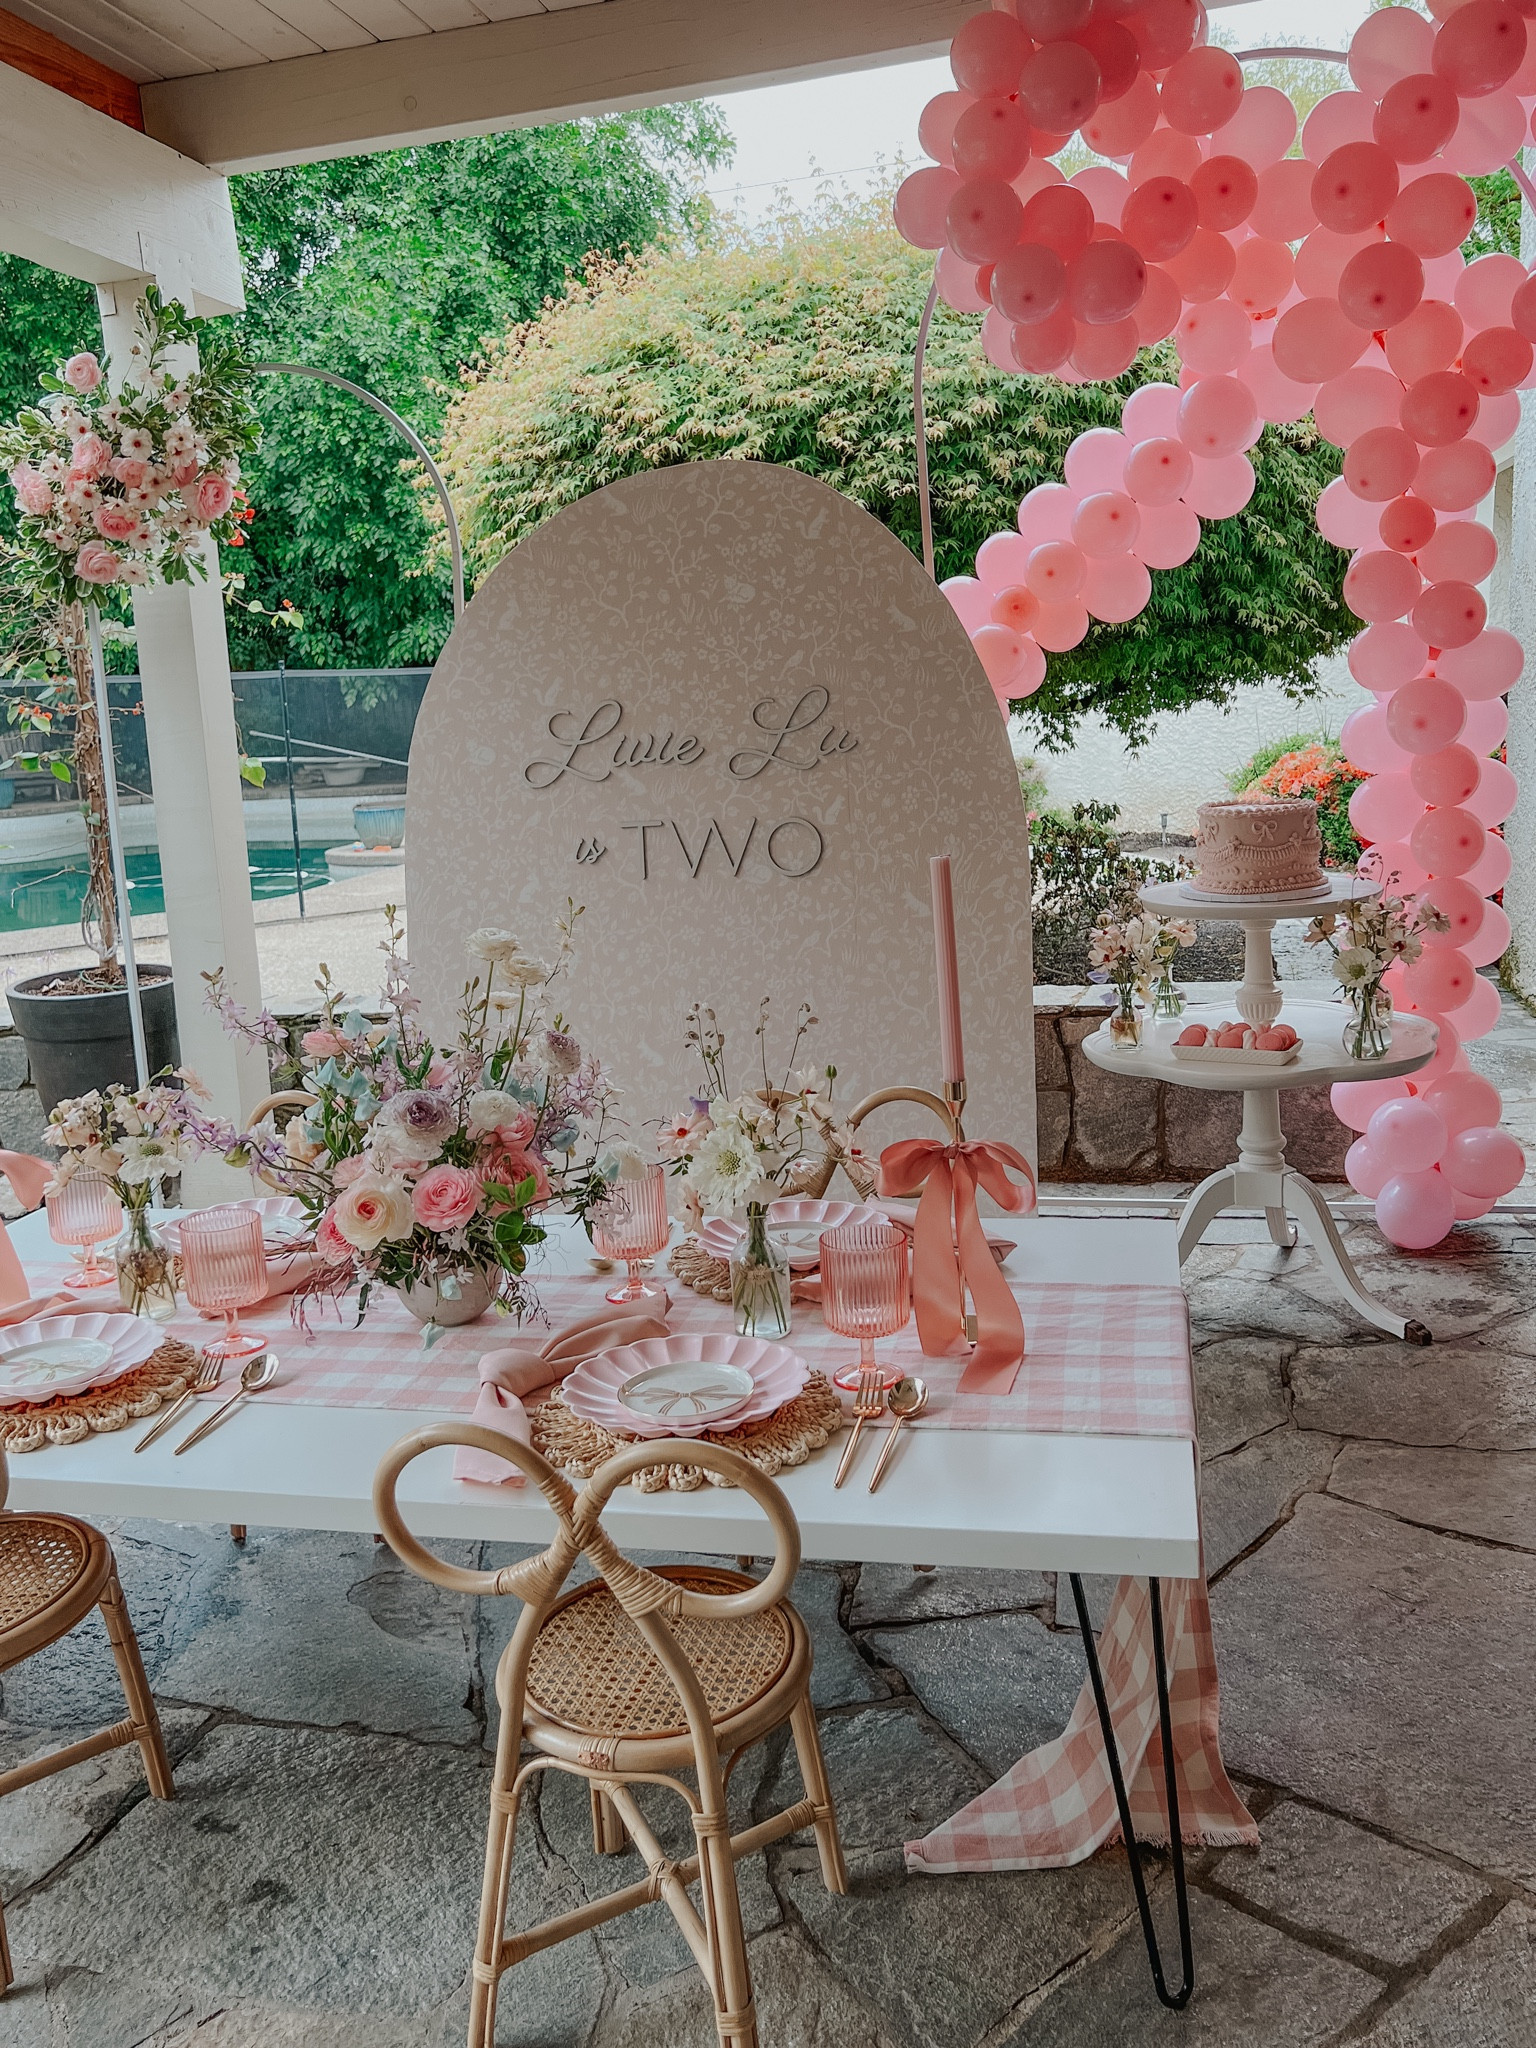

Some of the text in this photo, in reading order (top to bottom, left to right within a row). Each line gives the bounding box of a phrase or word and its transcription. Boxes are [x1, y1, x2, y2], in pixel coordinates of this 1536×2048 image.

[728, 684, 859, 780] Lu
[575, 816, 824, 880] is TWO
